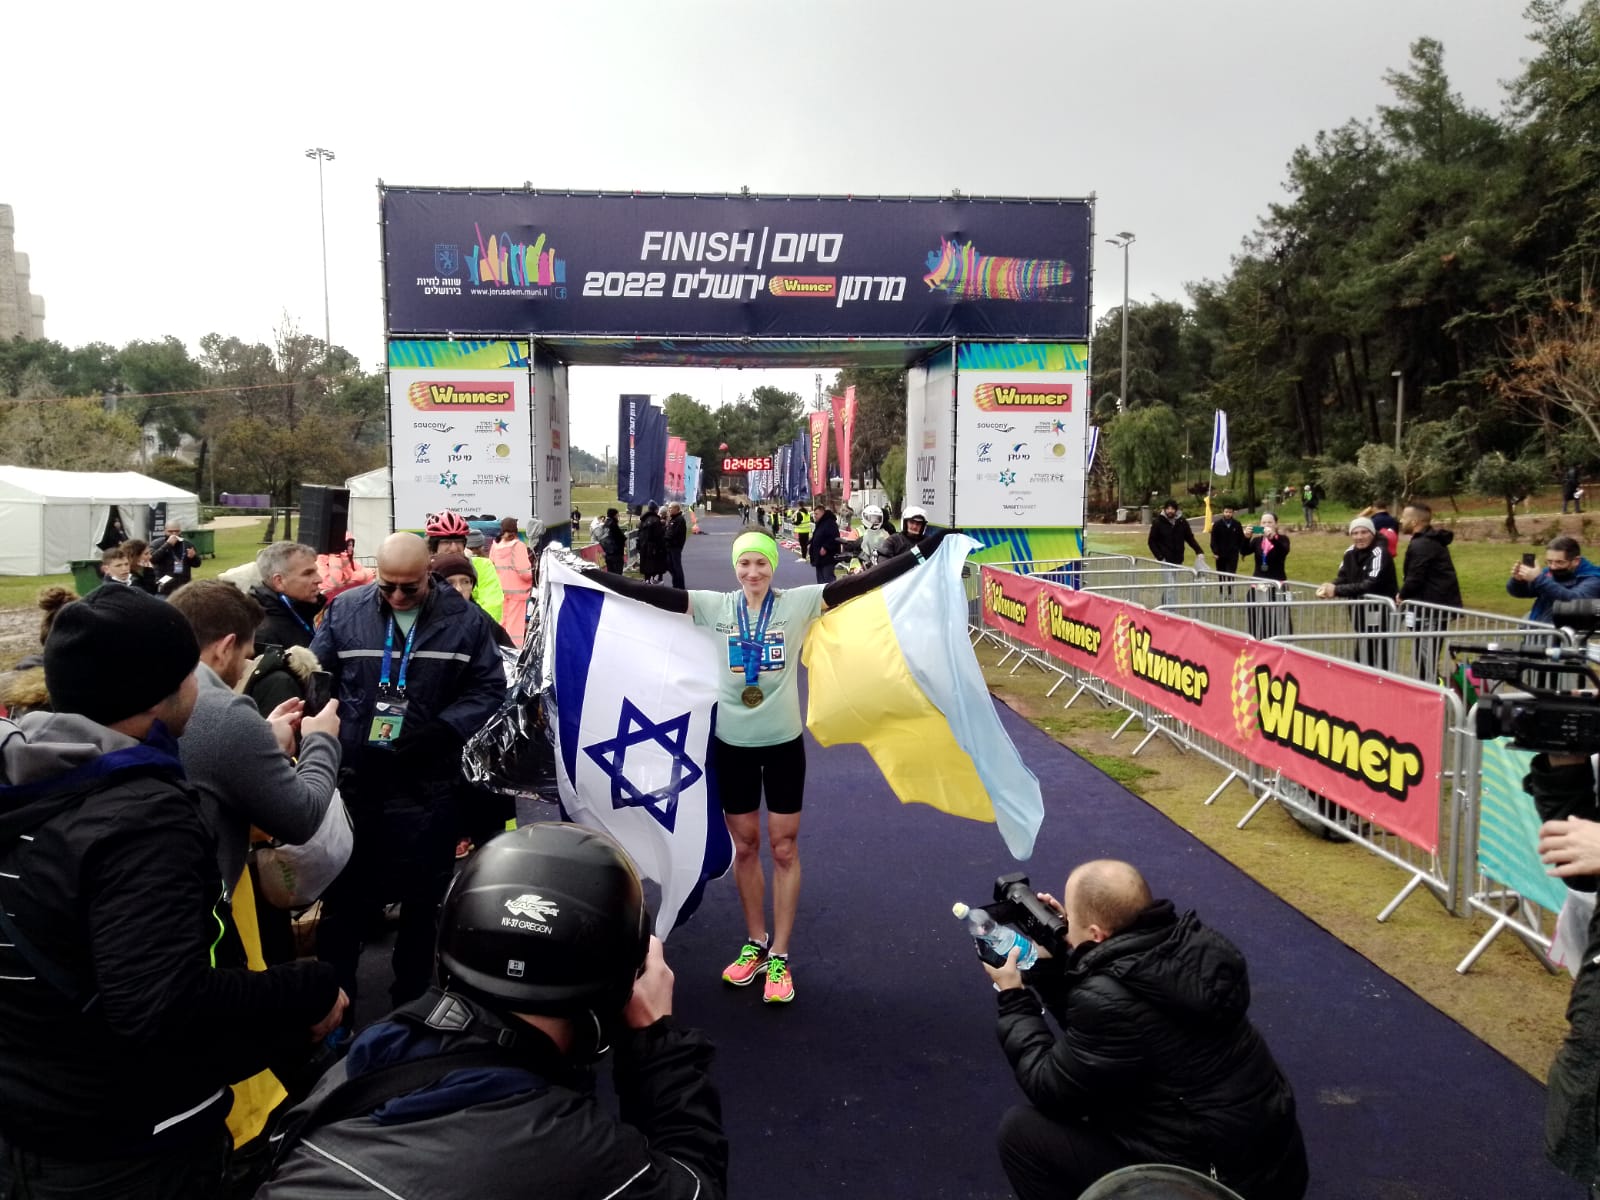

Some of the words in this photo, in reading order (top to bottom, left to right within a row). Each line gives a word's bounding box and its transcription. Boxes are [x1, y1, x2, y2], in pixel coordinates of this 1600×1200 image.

[640, 231, 754, 262] FINISH
[771, 233, 844, 263] סיום
[582, 272, 666, 297] 2022
[671, 267, 767, 300] ירושלים
[783, 278, 833, 293] Winner
[836, 275, 907, 308] מרתון
[429, 384, 511, 406] Winner
[994, 386, 1069, 406] Winner
[414, 422, 447, 430] saucony
[976, 422, 1008, 430] saucony
[723, 458, 771, 470] 02:48:55
[811, 431, 822, 486] Winner
[991, 579, 1027, 626] Winner
[1048, 597, 1101, 657] Winner
[1128, 620, 1209, 704] Winner
[1256, 665, 1424, 802] Winner
[518, 920, 553, 935] OREGON
